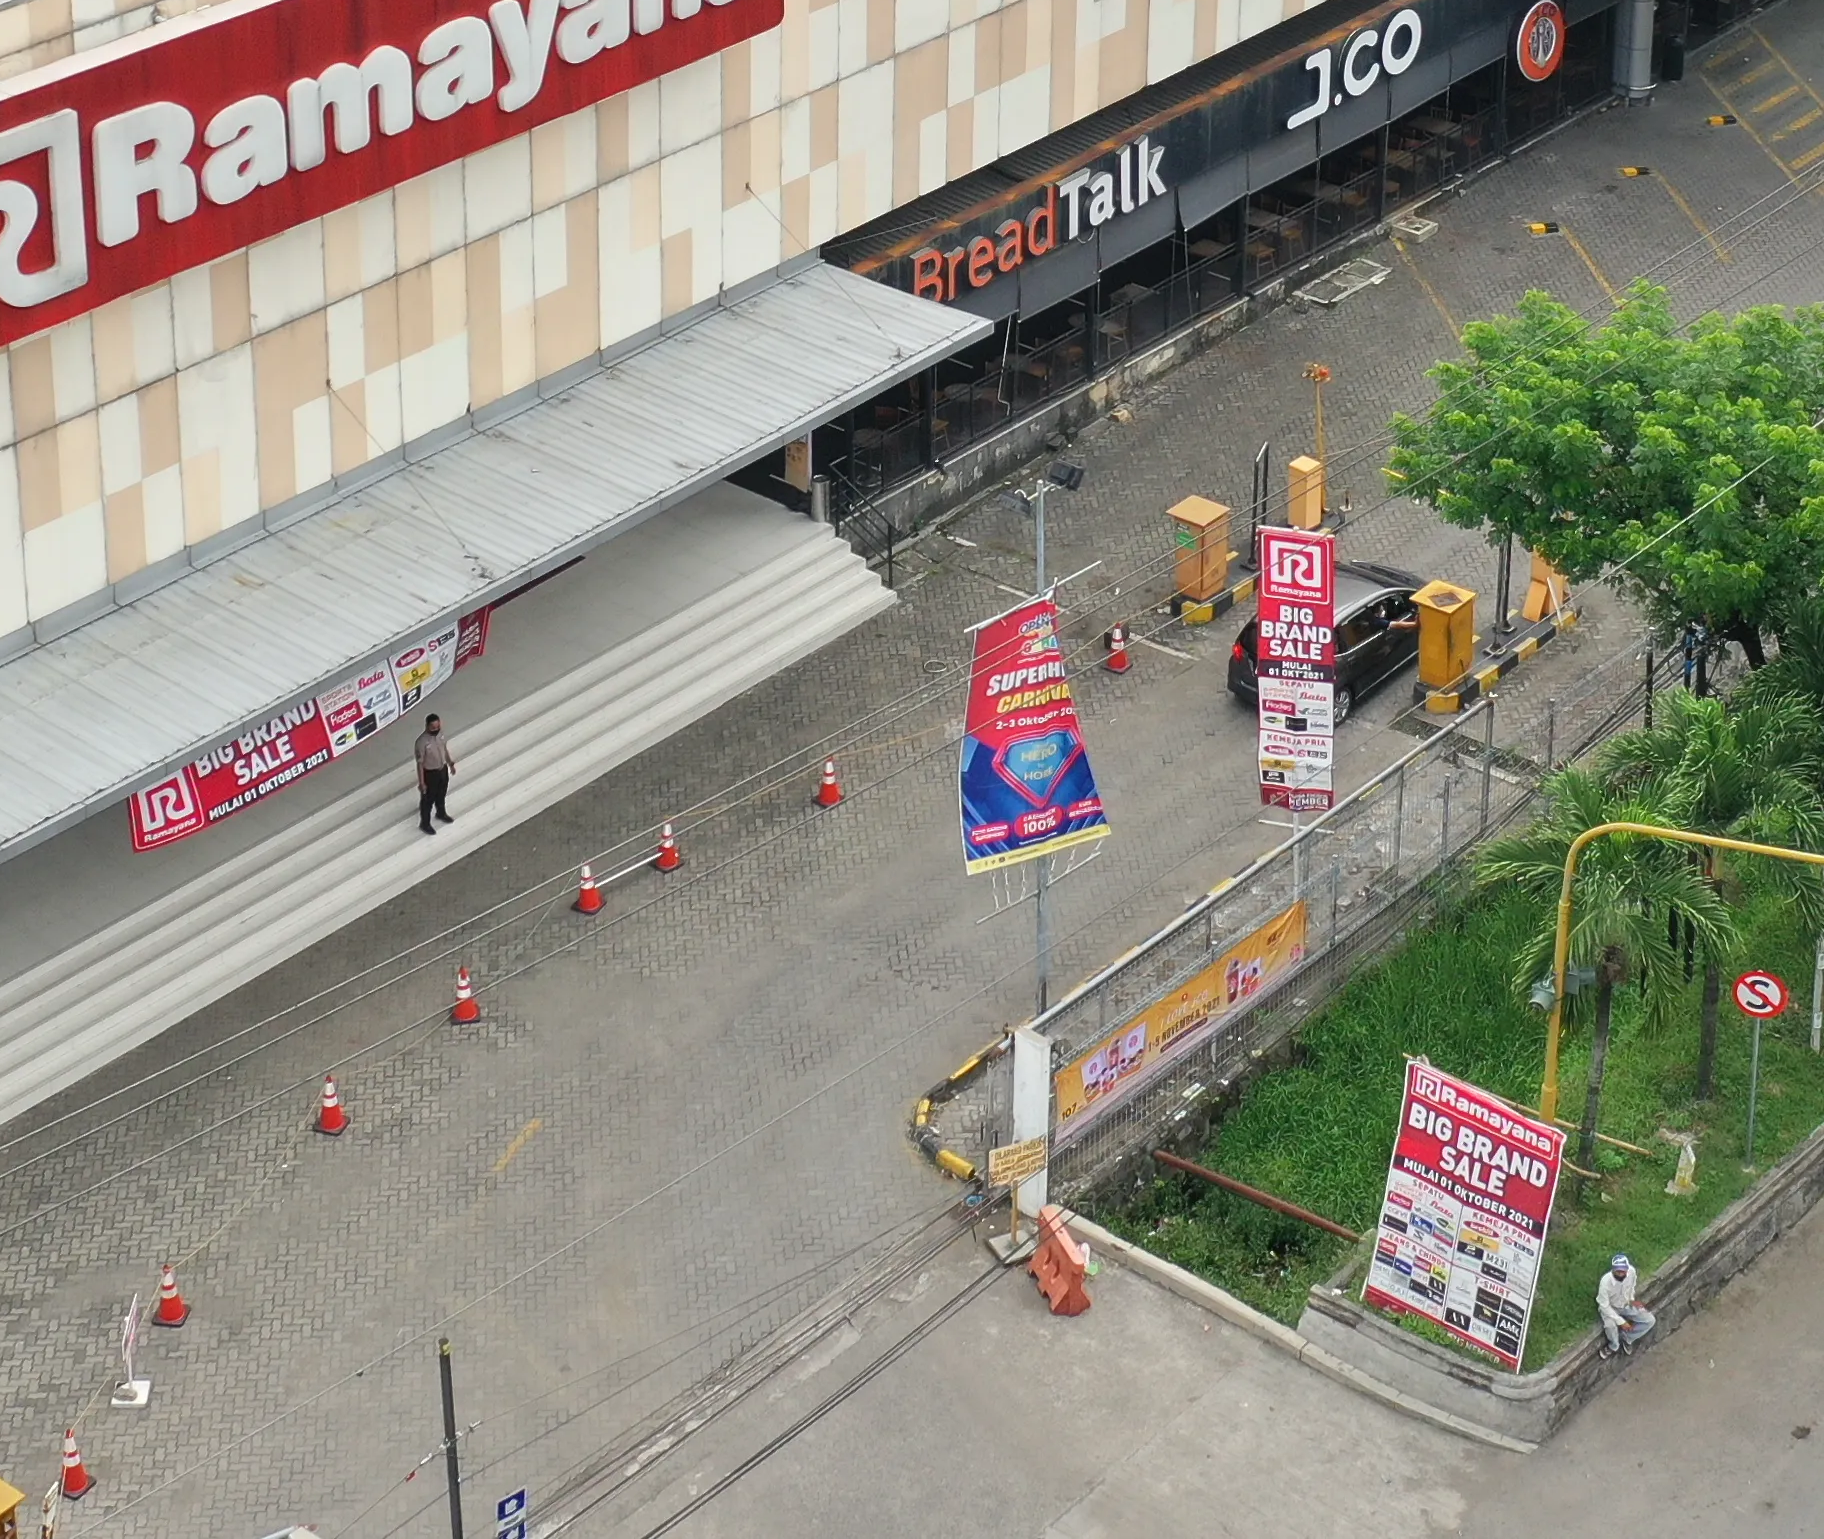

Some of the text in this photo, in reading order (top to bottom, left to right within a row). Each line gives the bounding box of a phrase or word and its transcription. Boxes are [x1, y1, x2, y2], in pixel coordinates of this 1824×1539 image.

[1286, 8, 1422, 130] J.CO
[909, 133, 1168, 304] BreadTalk
[1260, 620, 1332, 644] BRAND
[1279, 604, 1313, 625] BIG
[1269, 639, 1322, 661] SALE
[1282, 661, 1312, 671] MULAI
[194, 699, 316, 778] BIG BRAND
[234, 735, 295, 786] SALE
[209, 748, 329, 821] MULAI 01 OKTOBER 2021
[143, 817, 197, 843] Ramayana
[1023, 816, 1056, 835] 100%
[1440, 1084, 1551, 1153] Ramayana
[1408, 1102, 1548, 1188] BIG BRAND
[1439, 1145, 1507, 1197] SALE
[1403, 1157, 1440, 1185] MULAI
[1440, 1177, 1452, 1191] 01
[1454, 1185, 1507, 1218] OKTOBER
[1509, 1209, 1534, 1231] 2021
